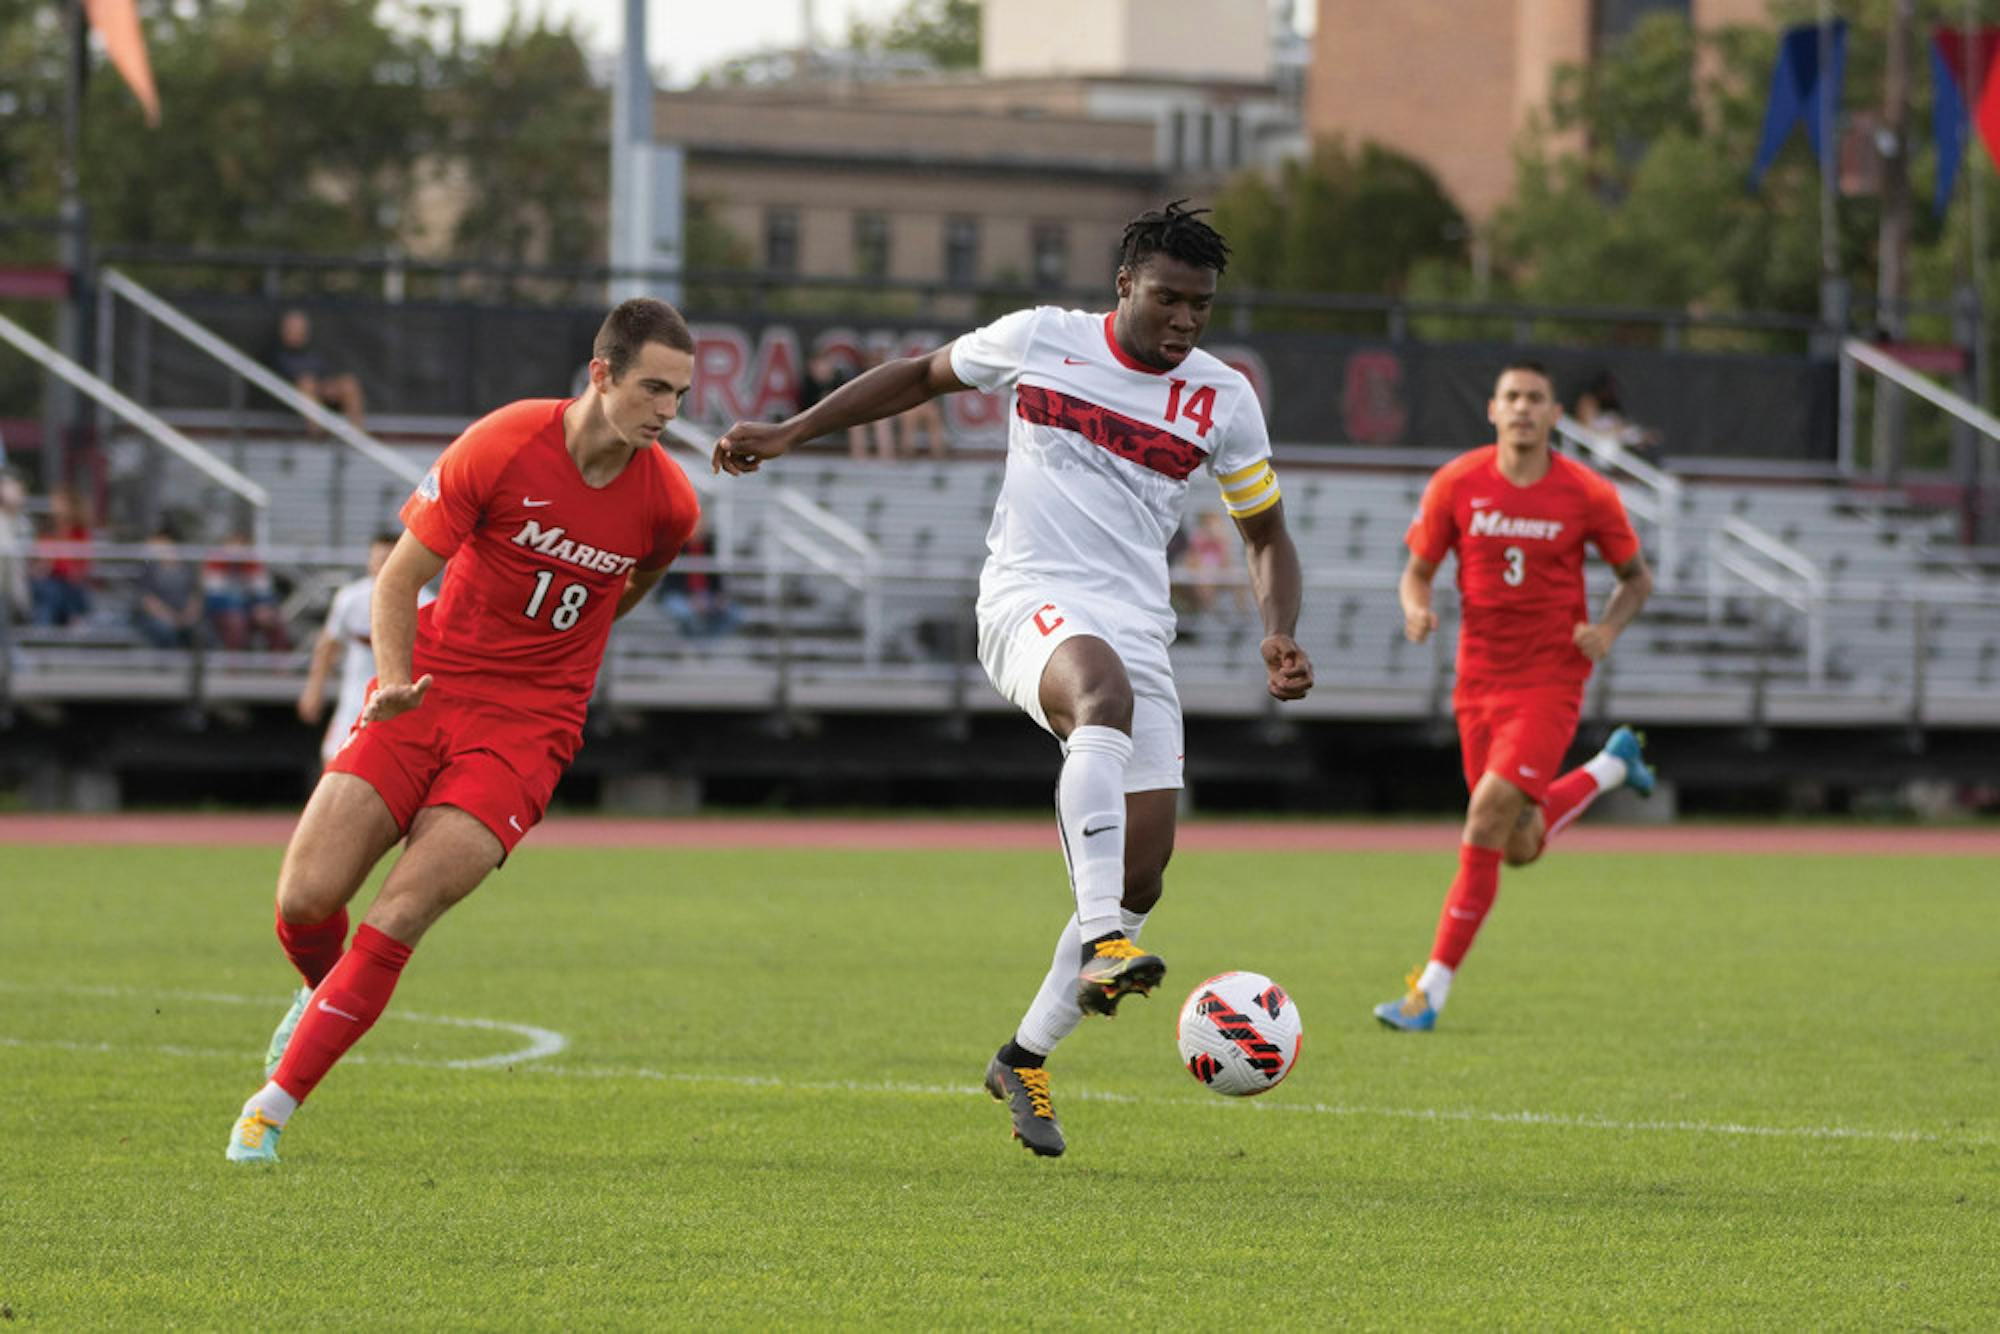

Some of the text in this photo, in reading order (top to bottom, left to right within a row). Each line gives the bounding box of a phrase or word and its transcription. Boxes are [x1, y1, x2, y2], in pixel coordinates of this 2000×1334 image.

[1163, 377, 1217, 439] 14
[1502, 546, 1525, 587] 3
[522, 569, 589, 632] 18
[1032, 604, 1064, 636] C
